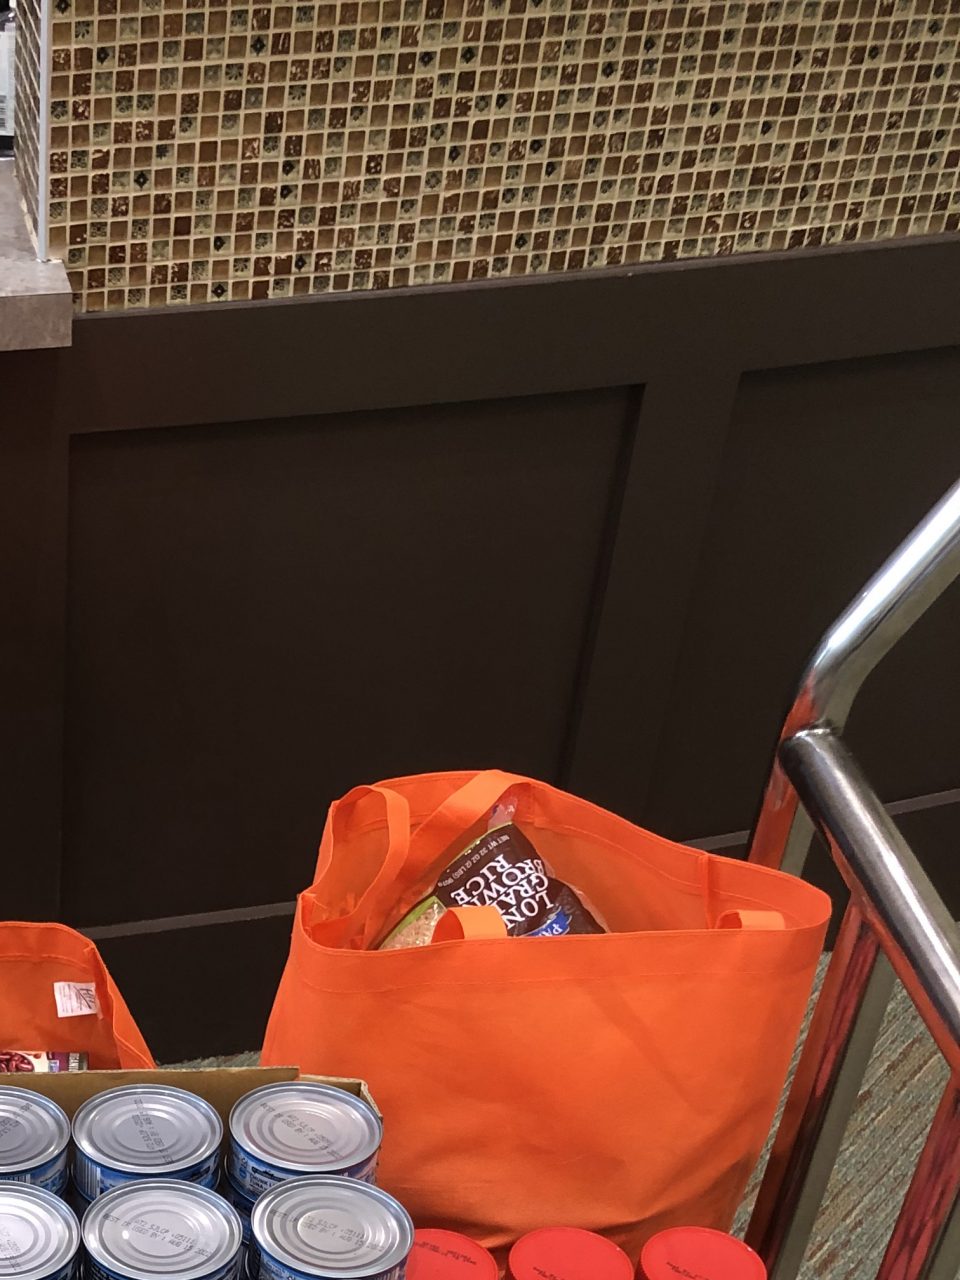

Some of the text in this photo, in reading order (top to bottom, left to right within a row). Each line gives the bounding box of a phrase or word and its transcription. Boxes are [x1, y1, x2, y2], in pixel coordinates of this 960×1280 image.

[451, 853, 512, 904] RICE
[492, 873, 548, 915] GRAI
[502, 890, 555, 929] LON
